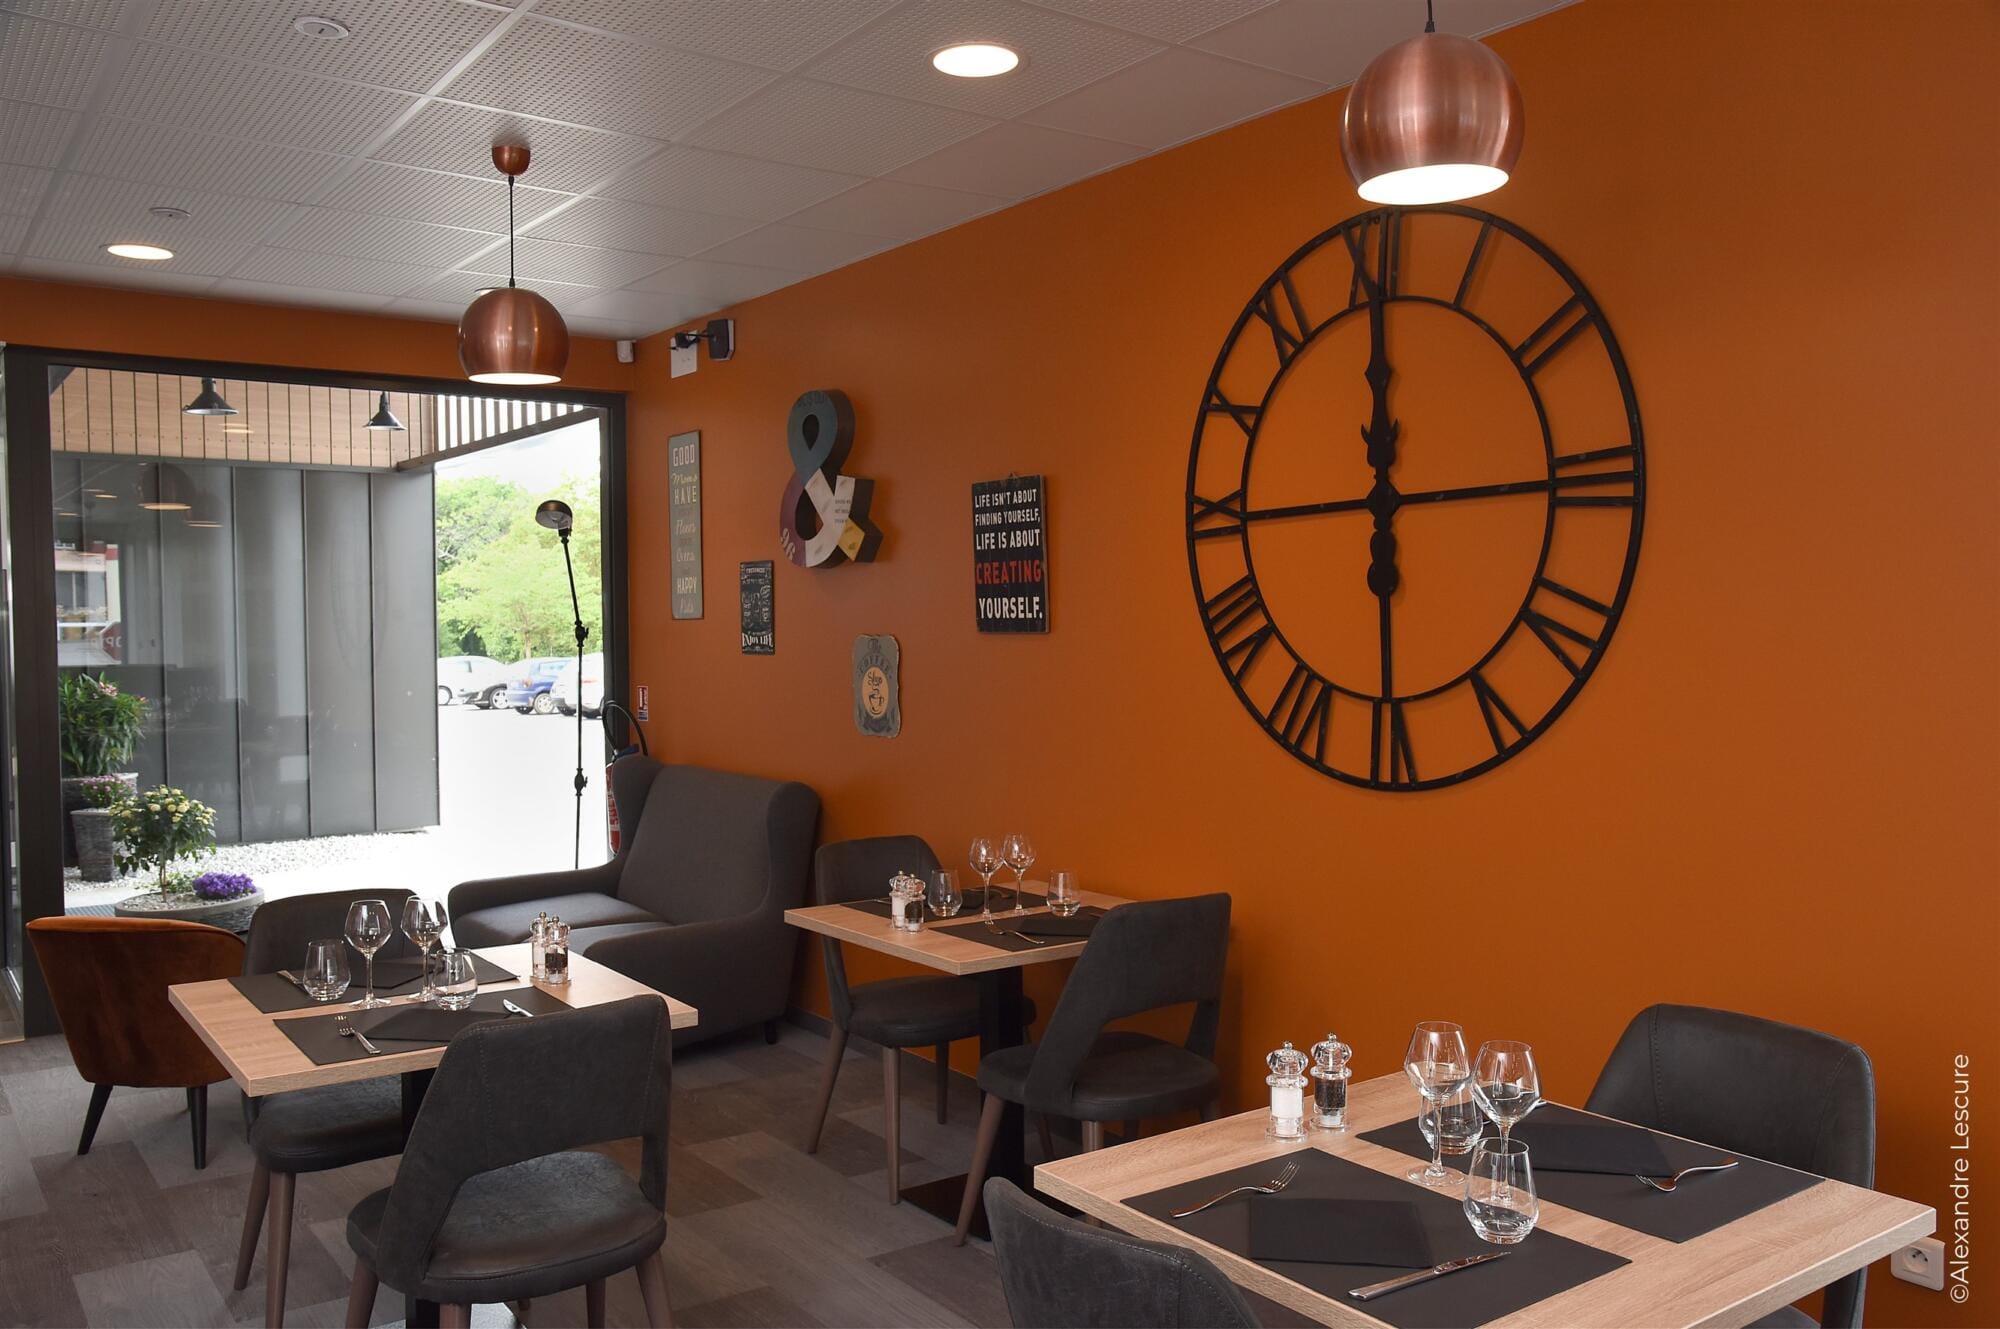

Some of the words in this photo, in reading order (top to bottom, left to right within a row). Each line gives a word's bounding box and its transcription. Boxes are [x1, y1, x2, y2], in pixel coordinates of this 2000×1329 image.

[672, 443, 695, 467] GOOD
[674, 485, 697, 505] HAVE
[974, 494, 991, 508] LIFE
[991, 491, 1011, 507] ISN'T
[1012, 488, 1037, 504] ABOUT
[975, 511, 1002, 527] FINDING
[1003, 508, 1041, 524] YOURSELF,
[975, 531, 996, 550] LIFE
[998, 530, 1007, 549] IS
[1009, 528, 1041, 549] ABOUT
[976, 559, 1042, 585] CREATING
[676, 575, 697, 594] HAPPY
[978, 596, 1043, 619] YOURSELF.
[741, 632, 758, 647] ENJOY
[759, 632, 774, 648] LIFE
